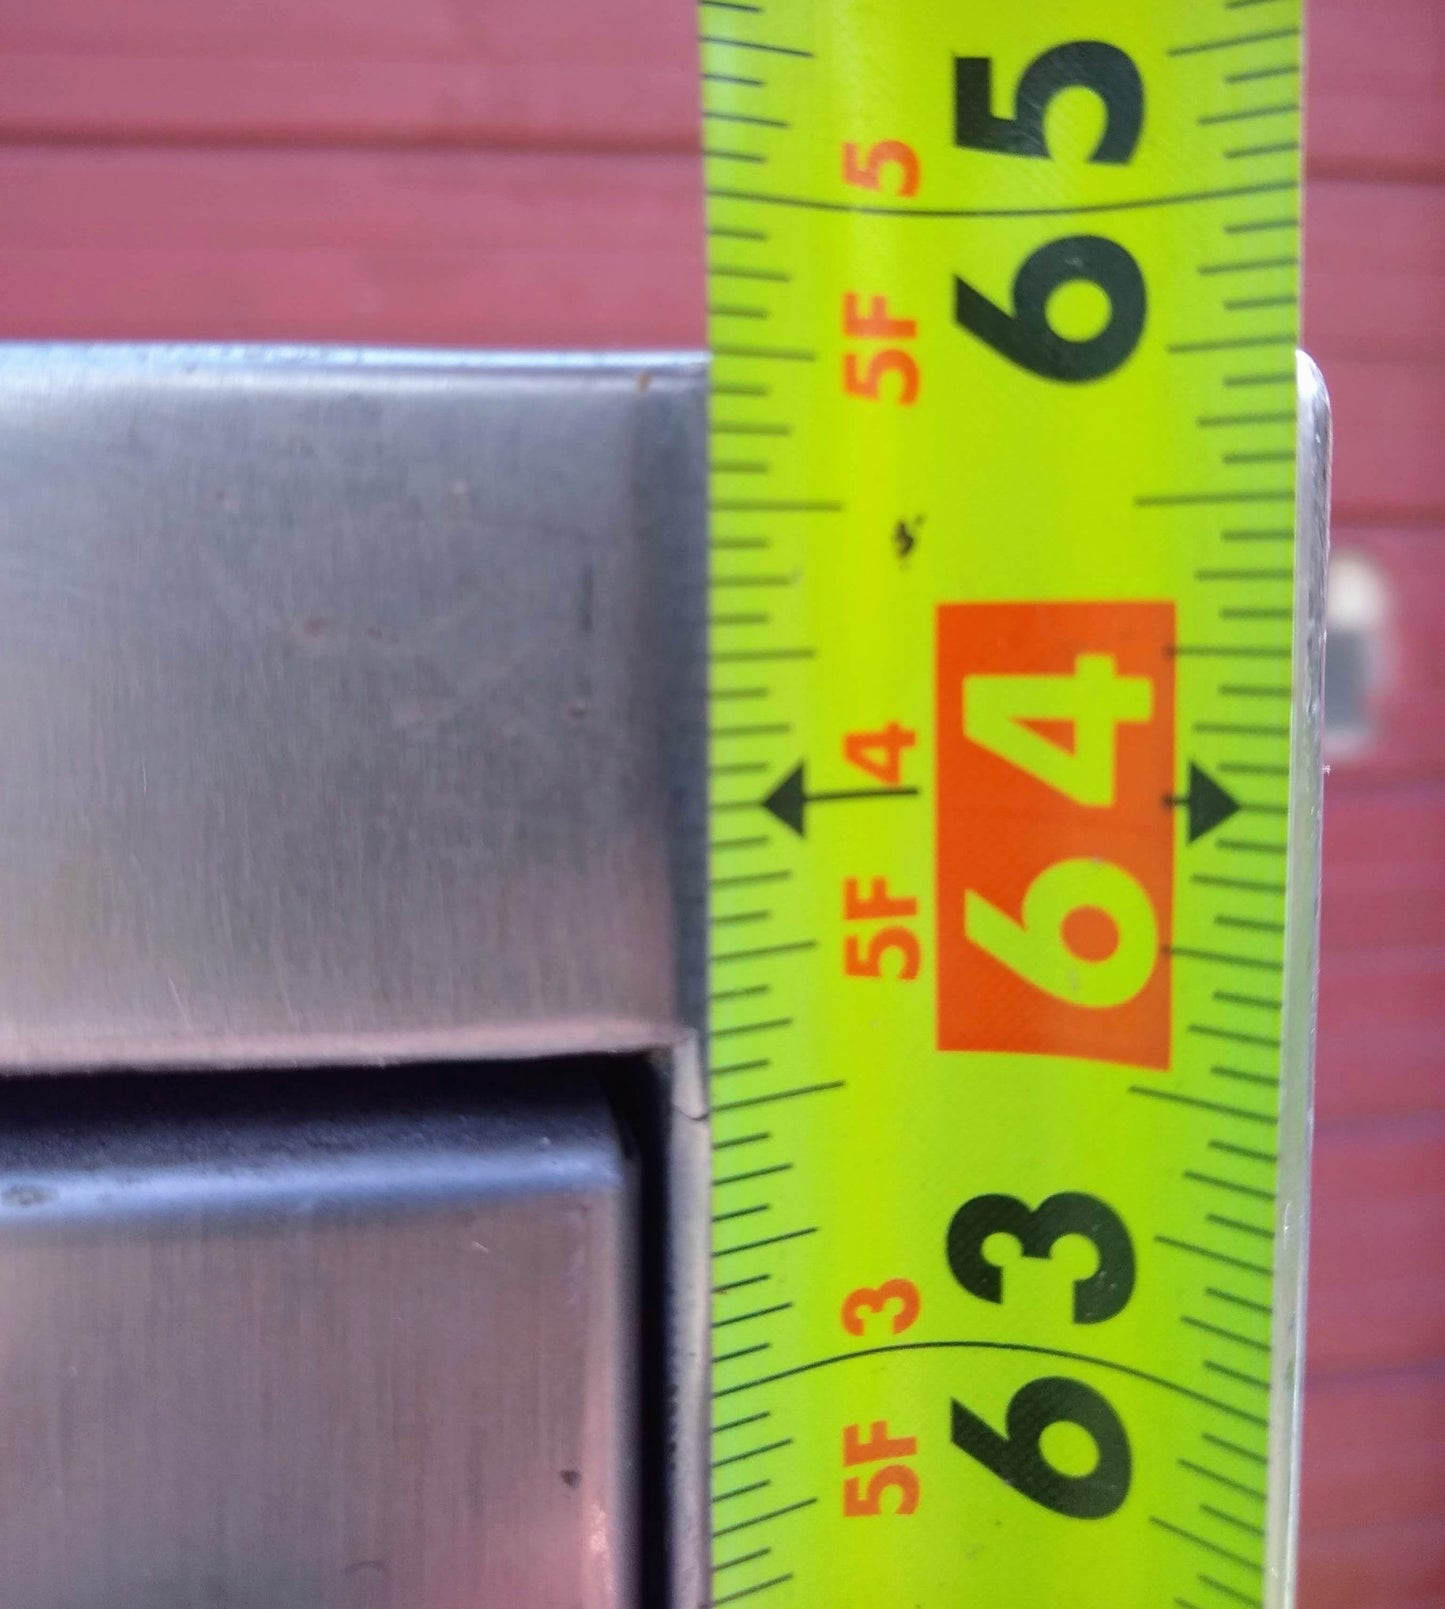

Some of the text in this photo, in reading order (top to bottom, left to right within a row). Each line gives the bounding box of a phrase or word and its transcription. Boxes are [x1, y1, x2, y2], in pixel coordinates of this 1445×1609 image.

[842, 139, 920, 406] 5F 5
[953, 39, 1146, 386] 65
[843, 720, 920, 982] 5F 4
[961, 652, 1156, 1010] 64
[841, 1278, 920, 1517] 5F 3
[946, 1191, 1137, 1521] 63
